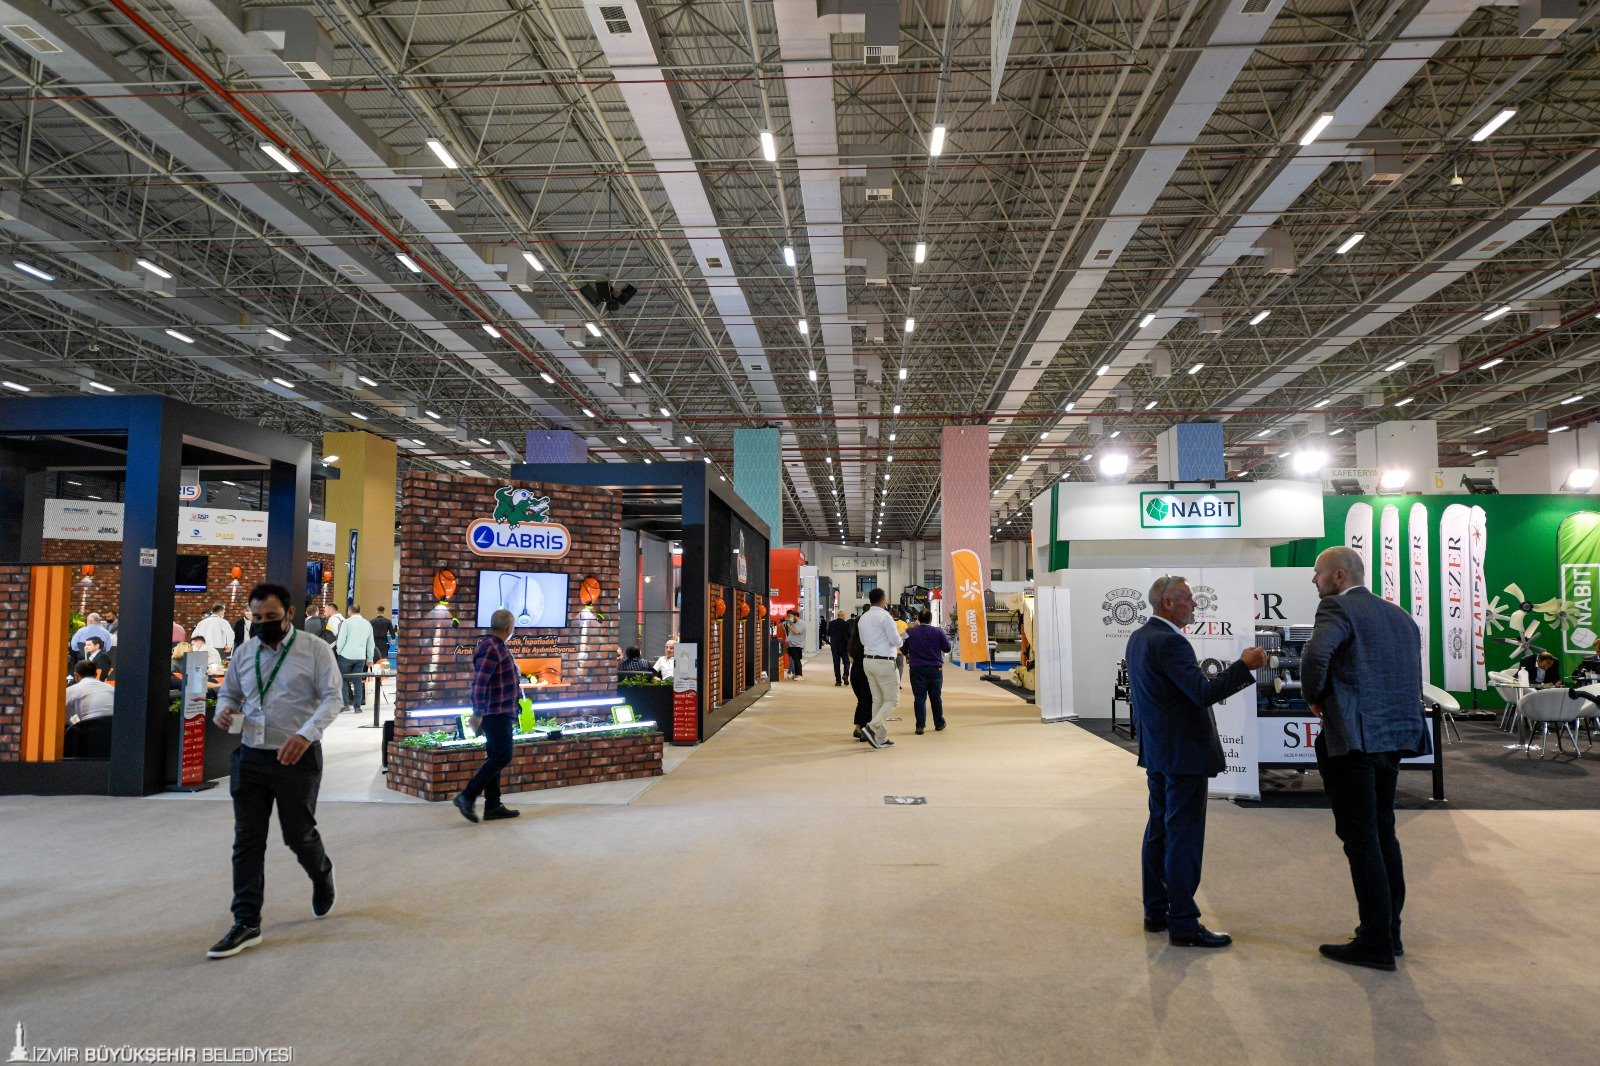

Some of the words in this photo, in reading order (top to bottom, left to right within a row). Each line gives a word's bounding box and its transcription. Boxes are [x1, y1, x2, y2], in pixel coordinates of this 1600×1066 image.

[1385, 536, 1394, 602] EZER
[1448, 536, 1462, 619] SEZER
[1574, 568, 1592, 626] NABIT
